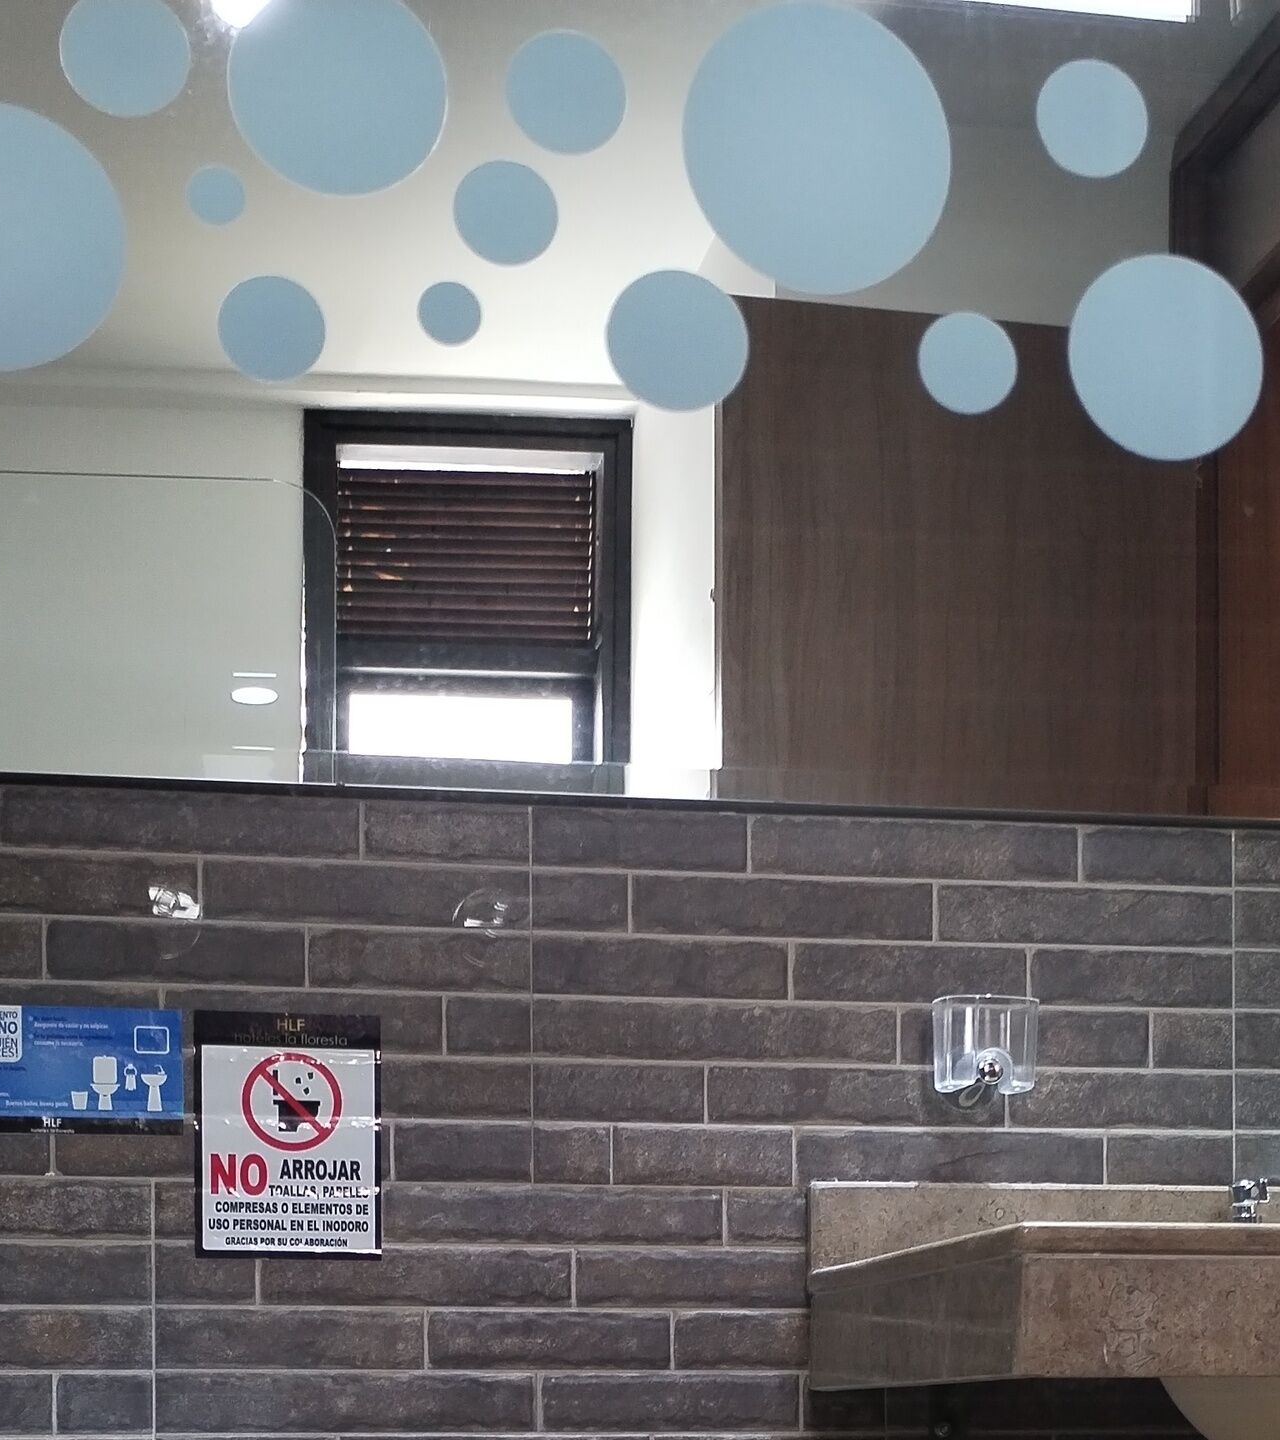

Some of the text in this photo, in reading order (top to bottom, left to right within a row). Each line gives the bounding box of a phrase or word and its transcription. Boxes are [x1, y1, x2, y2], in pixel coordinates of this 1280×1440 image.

[277, 1018, 305, 1032] HLF
[234, 1032, 348, 1046] hoteles la floresta
[43, 1118, 62, 1128] HLF
[210, 1153, 361, 1196] NO ARROJAR
[215, 1201, 369, 1216] COMPRESAS O ELEMENTOS DE
[208, 1218, 369, 1233] USO PERSONAL EN EL INODORO
[225, 1236, 258, 1246] GRACIAS
[260, 1237, 276, 1246] POR
[277, 1237, 288, 1247] SU
